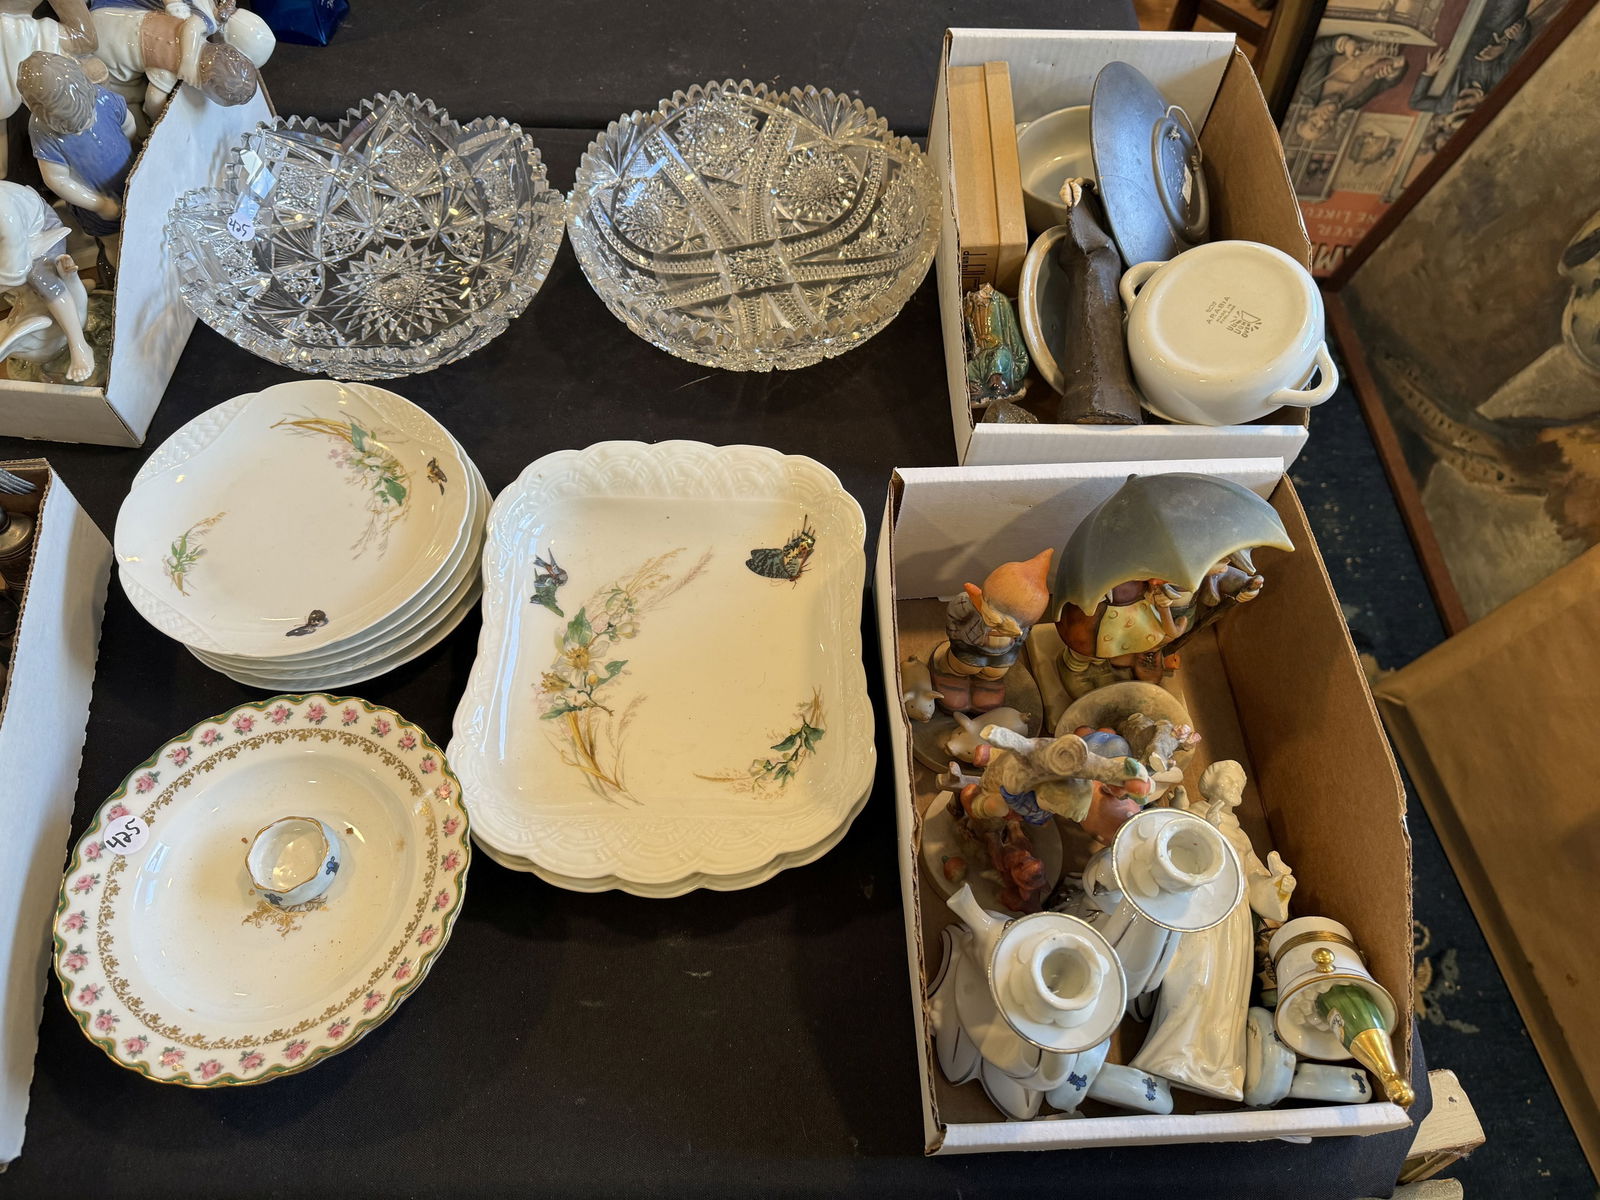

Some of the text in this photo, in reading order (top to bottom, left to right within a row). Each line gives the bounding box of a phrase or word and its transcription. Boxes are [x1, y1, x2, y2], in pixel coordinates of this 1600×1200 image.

[228, 218, 250, 238] 425
[1206, 296, 1230, 324] ARABIA
[105, 817, 141, 848] 425
